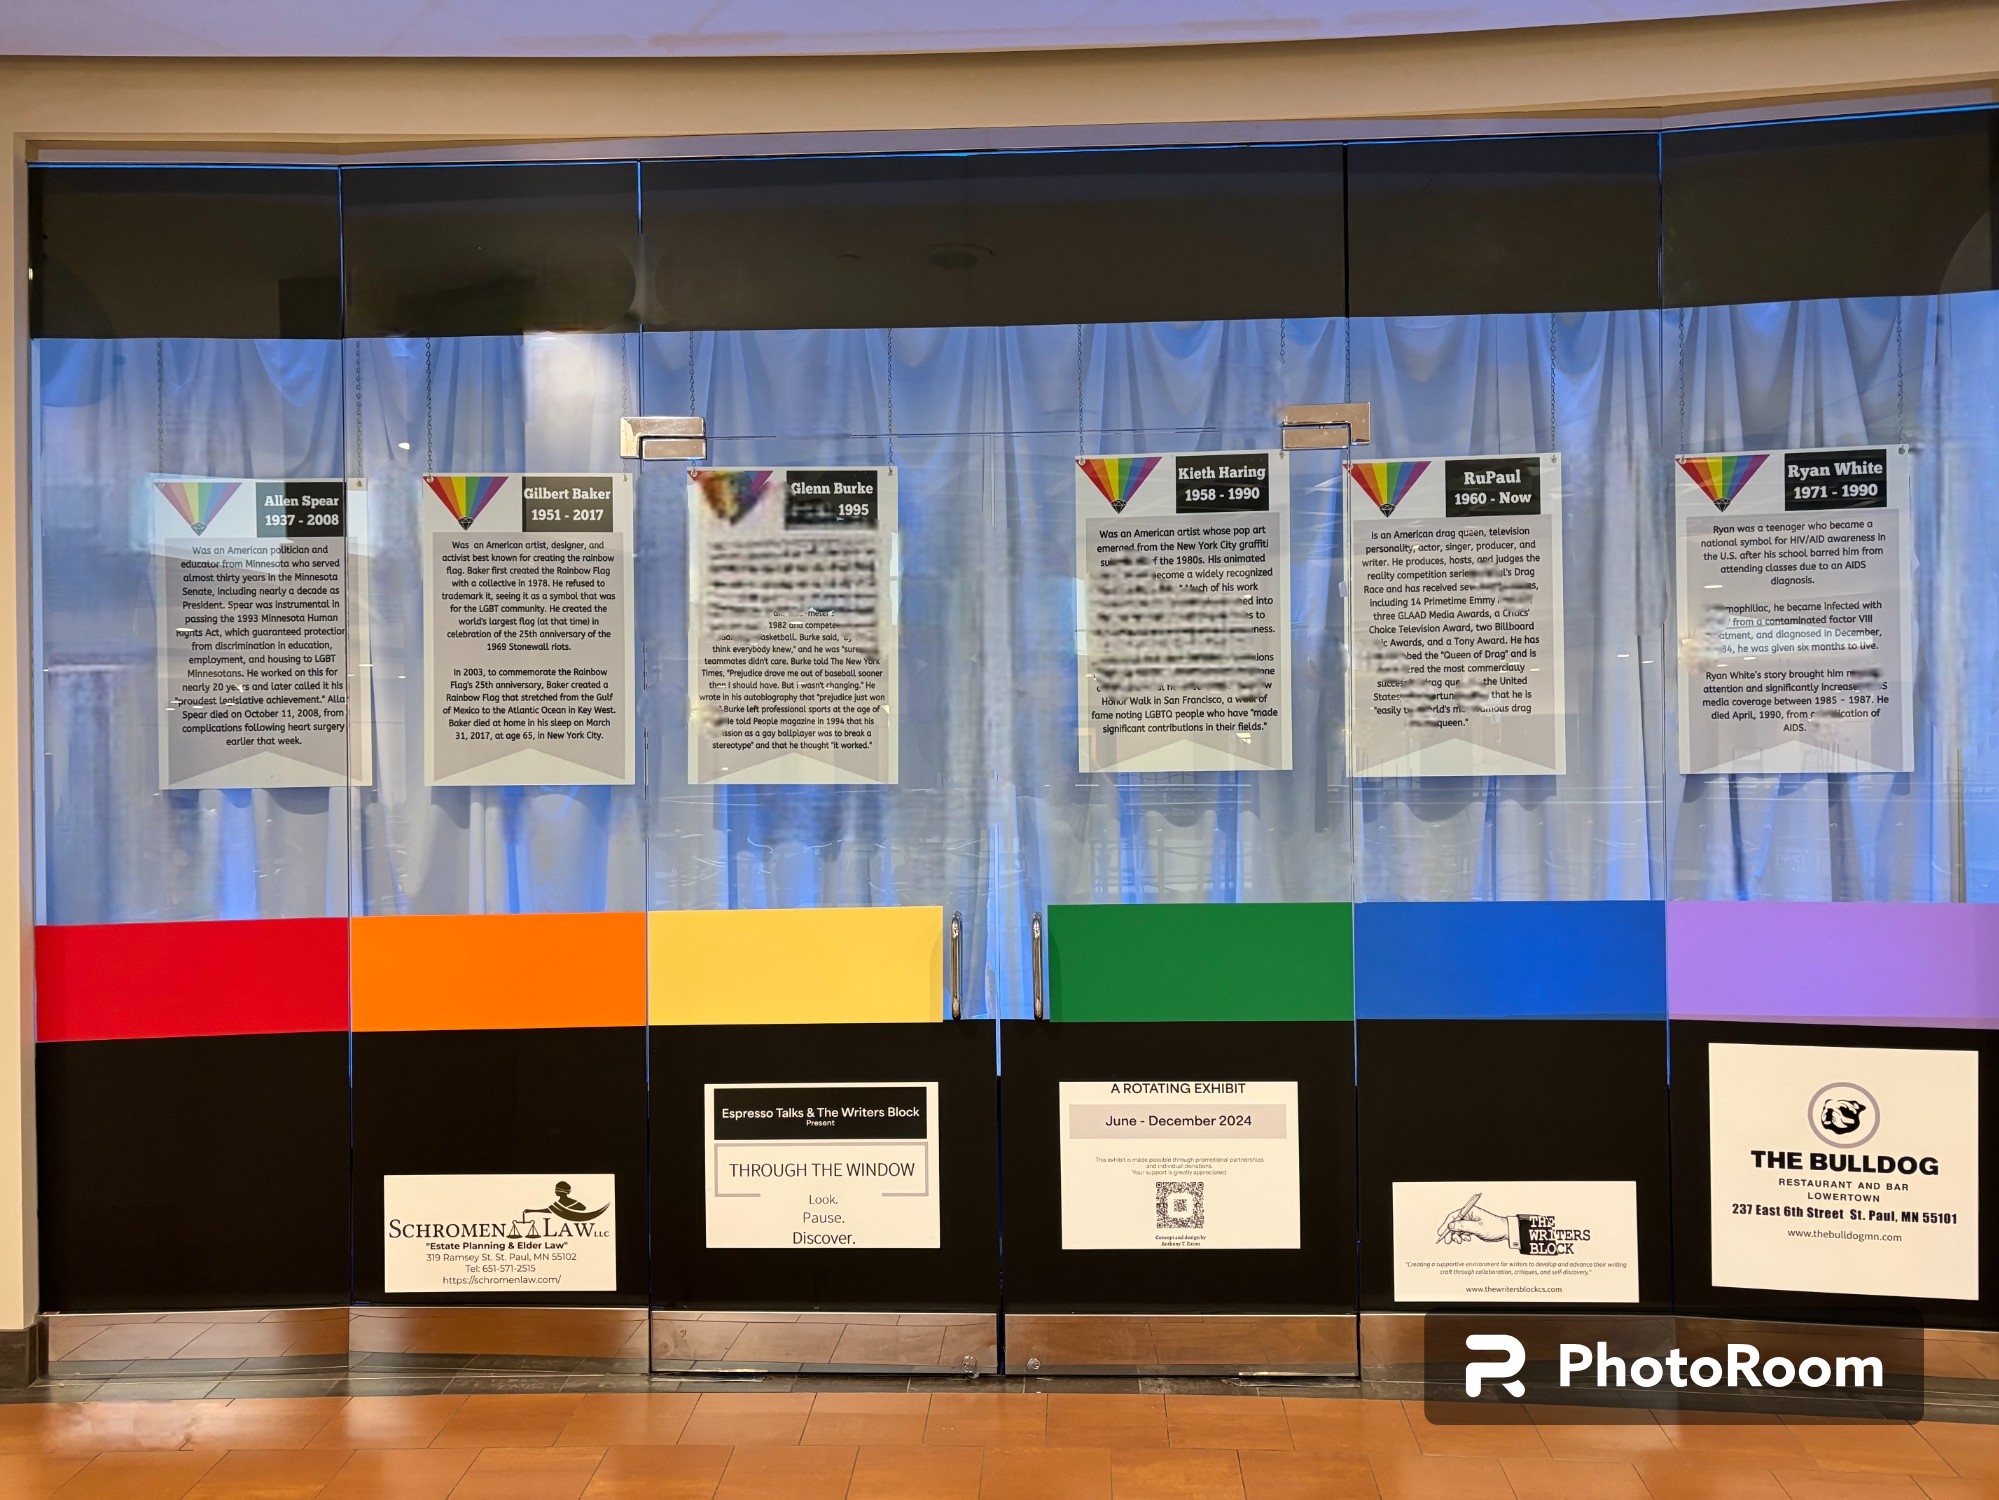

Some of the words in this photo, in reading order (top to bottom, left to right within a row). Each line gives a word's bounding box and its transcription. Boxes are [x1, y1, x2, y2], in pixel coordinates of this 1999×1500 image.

[1178, 466, 1215, 479] Kieth
[1219, 465, 1265, 480] Haring
[1464, 469, 1520, 484] RuPaul
[1788, 464, 1830, 480] Ryan
[1833, 462, 1882, 475] White
[524, 487, 569, 499] Gilbert
[572, 487, 610, 499] Baker
[791, 482, 830, 494] Glenn
[834, 482, 873, 493] Burke
[1185, 488, 1215, 501] 1958
[1228, 487, 1259, 499] 1990
[1794, 485, 1827, 498] 1971
[1842, 484, 1877, 496] 1990
[264, 495, 298, 506] Allen
[301, 495, 339, 508] Spear
[1455, 492, 1486, 504] 1960
[1499, 491, 1531, 503] Now
[531, 509, 560, 520] 1951
[573, 509, 603, 520] 2017
[839, 504, 868, 515] 1995
[265, 514, 295, 525] 1937
[307, 514, 339, 525] 2008
[1099, 530, 1118, 538] Was
[1134, 528, 1174, 537] American
[1177, 527, 1200, 536] artist
[1203, 526, 1230, 535] whose
[1233, 527, 1250, 536] pop
[1713, 525, 1734, 535] Ryan
[1765, 523, 1805, 533] teenager
[1808, 521, 1827, 529] who
[1830, 520, 1864, 529] became
[446, 566, 464, 576] flag.
[467, 566, 489, 574] Baker
[491, 566, 507, 574] first
[509, 566, 539, 574] created
[541, 566, 554, 574] the
[557, 566, 590, 574] Rainbow
[593, 566, 610, 576] Flag
[183, 573, 213, 581] almost
[216, 573, 239, 583] thirty
[242, 575, 265, 583] years
[268, 573, 275, 581] in
[278, 572, 292, 581] the
[294, 572, 337, 580] Minnesota
[1369, 625, 1396, 634] Choice
[1398, 624, 1440, 633] Television
[1442, 623, 1473, 633] Award,
[1475, 623, 1492, 631] two
[1495, 621, 1534, 630] Billboard
[701, 669, 724, 677] Times,
[727, 669, 762, 678] "Prejudice
[1111, 1083, 1120, 1093] A
[1123, 1083, 1190, 1093] ROTATING
[1194, 1083, 1245, 1093] EXHIBIT
[722, 1108, 773, 1120] Espresso
[776, 1107, 803, 1117] Talks
[807, 1107, 814, 1117] &
[817, 1107, 838, 1117] The
[841, 1106, 884, 1117] Writers
[888, 1106, 919, 1116] Block
[1105, 1116, 1136, 1125] June
[1149, 1116, 1216, 1125] December
[1219, 1116, 1251, 1125] 2024
[1751, 1150, 1803, 1169] THE
[1810, 1153, 1939, 1174] BULLDOG
[729, 1163, 806, 1177] THROUGH
[811, 1163, 842, 1176] THE
[846, 1162, 914, 1176] WINDOW
[1779, 1178, 1853, 1188] RESTAURANT
[1886, 1183, 1909, 1191] BAR
[809, 1194, 837, 1204] Look.
[1807, 1192, 1880, 1202] LOWERTOWN
[803, 1212, 844, 1223] Pause.
[1732, 1203, 1753, 1214] 237
[1756, 1204, 1781, 1216] East
[1784, 1206, 1804, 1217] 6th
[1807, 1207, 1844, 1219] Street
[1850, 1209, 1866, 1220] St.
[1869, 1210, 1898, 1222] Paul,
[1901, 1211, 1919, 1222] MN
[1923, 1212, 1957, 1224] 55101
[1529, 1216, 1555, 1228] THE
[793, 1232, 855, 1244] Discover.
[1529, 1229, 1591, 1241] WRITERS
[1787, 1229, 1902, 1242] www.thebulldogmn.com
[463, 1241, 505, 1251] Planning
[517, 1241, 541, 1249] Elder
[545, 1241, 567, 1249] Law"
[1529, 1243, 1574, 1254] BLOCK
[426, 1253, 440, 1261] 319
[443, 1253, 479, 1262] Ramsey
[482, 1253, 492, 1261] St.
[509, 1253, 531, 1261] Paul,
[482, 1264, 535, 1272] 651-571-2515
[442, 1274, 561, 1285] https://schromenlaw.com/
